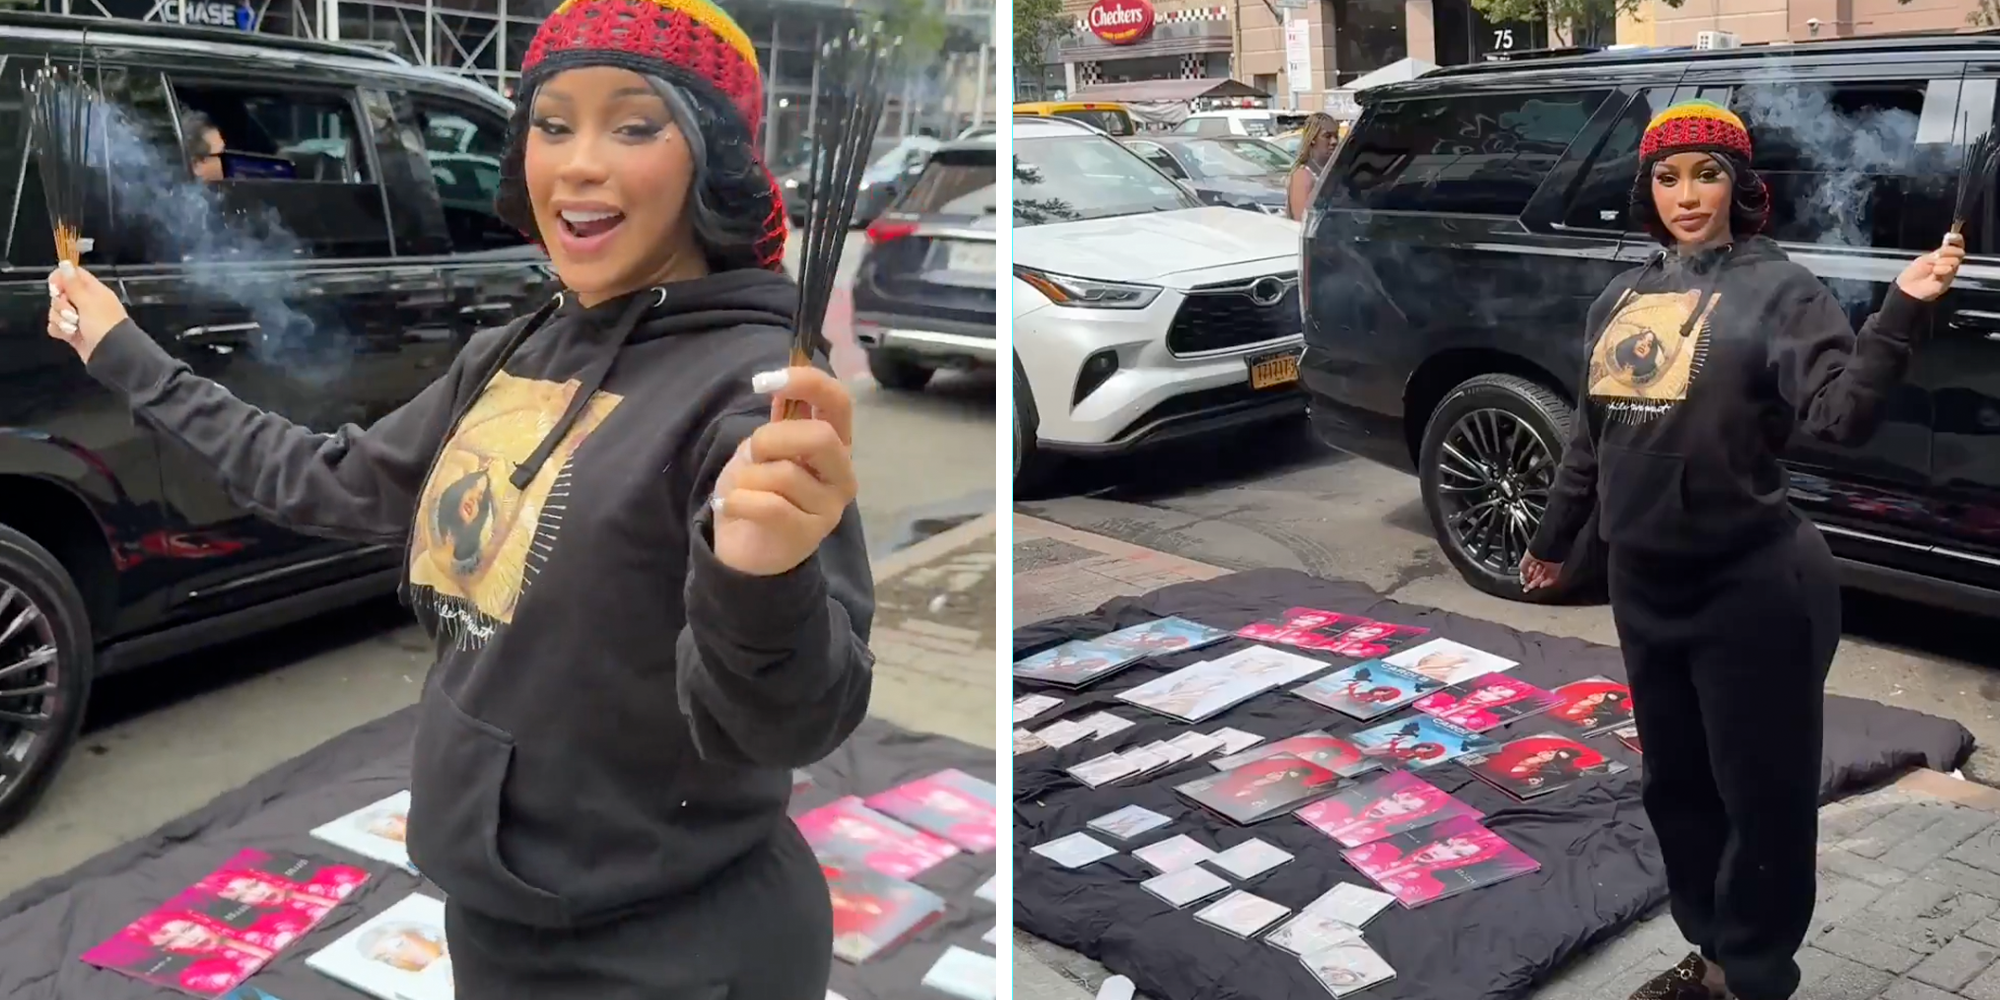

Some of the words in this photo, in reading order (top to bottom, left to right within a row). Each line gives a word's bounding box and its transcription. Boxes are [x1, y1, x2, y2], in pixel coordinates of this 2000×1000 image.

[165, 0, 236, 26] CHASE
[1091, 3, 1143, 27] Checkers
[1493, 29, 1514, 50] 75
[1380, 663, 1418, 679] CARDI
[1432, 718, 1469, 735] CARDI
